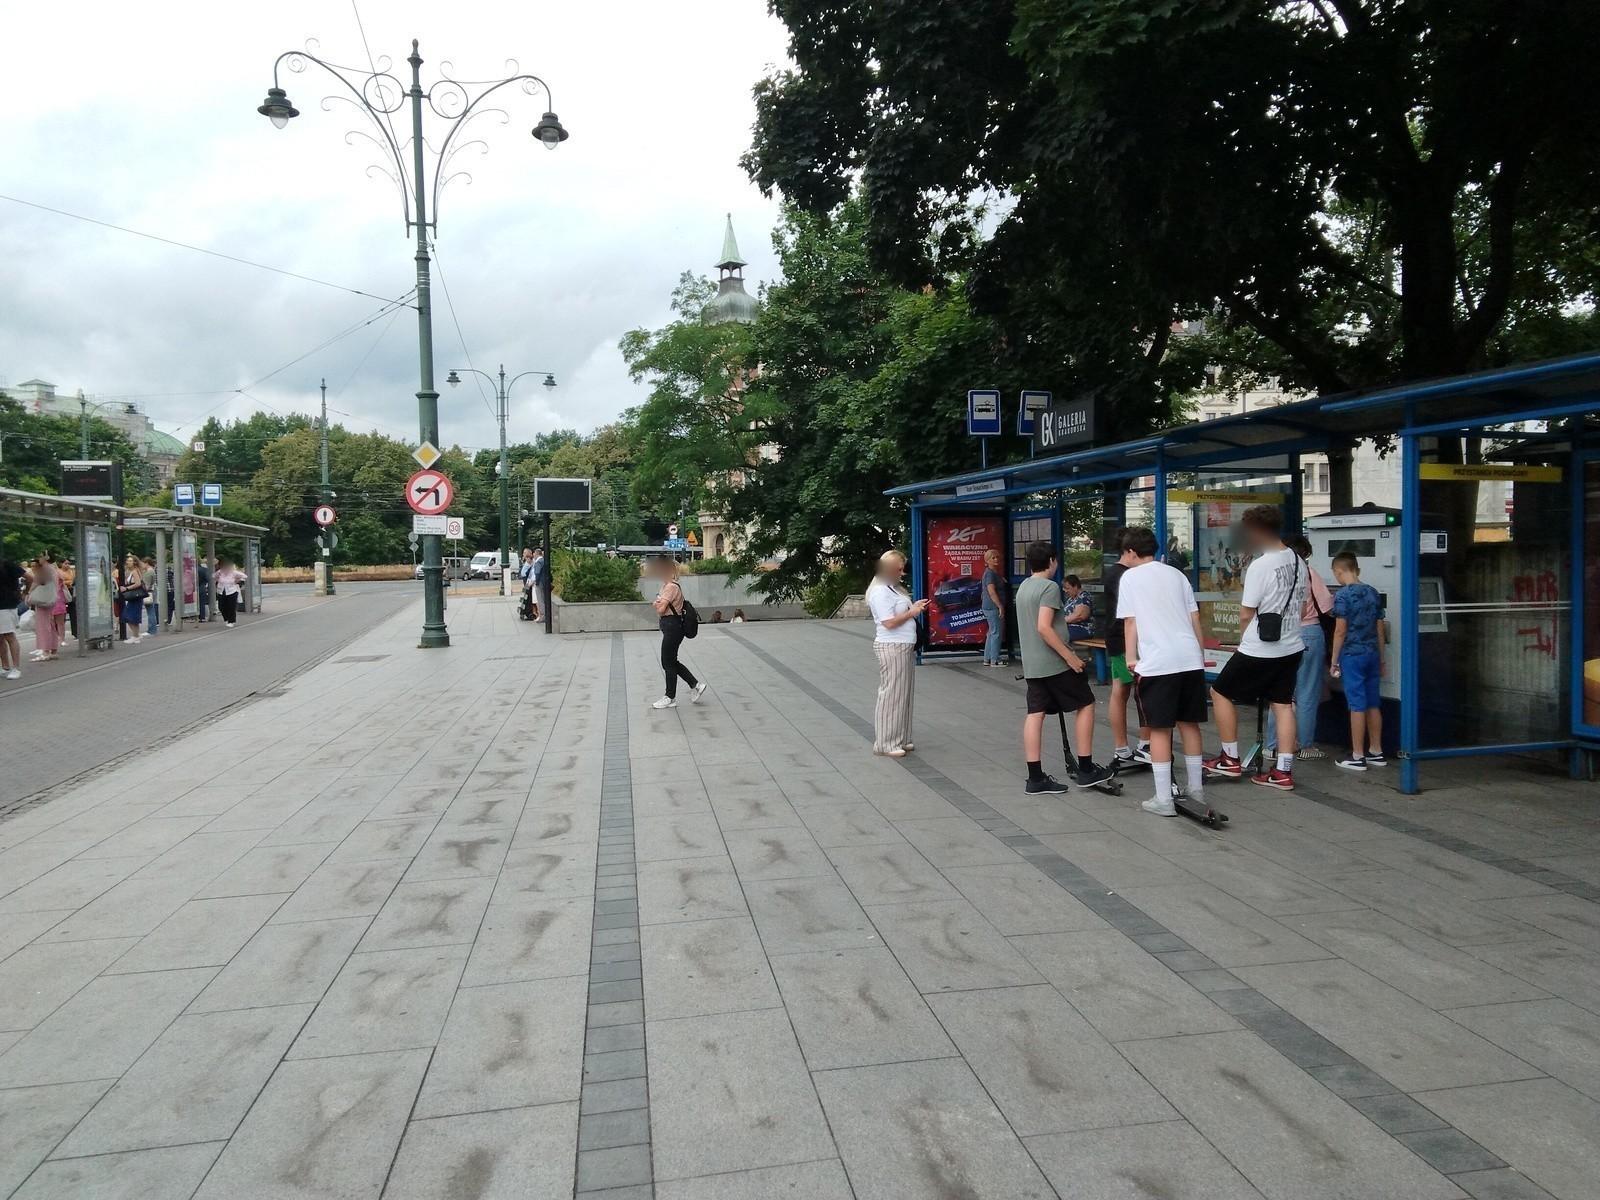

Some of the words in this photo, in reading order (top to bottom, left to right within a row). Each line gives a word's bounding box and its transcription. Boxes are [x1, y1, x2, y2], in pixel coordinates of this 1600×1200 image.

[1058, 410, 1086, 429] GALERIA
[1041, 412, 1055, 446] GK
[947, 527, 986, 543] ZET
[1213, 613, 1222, 623] W
[1222, 613, 1240, 625] KAR
